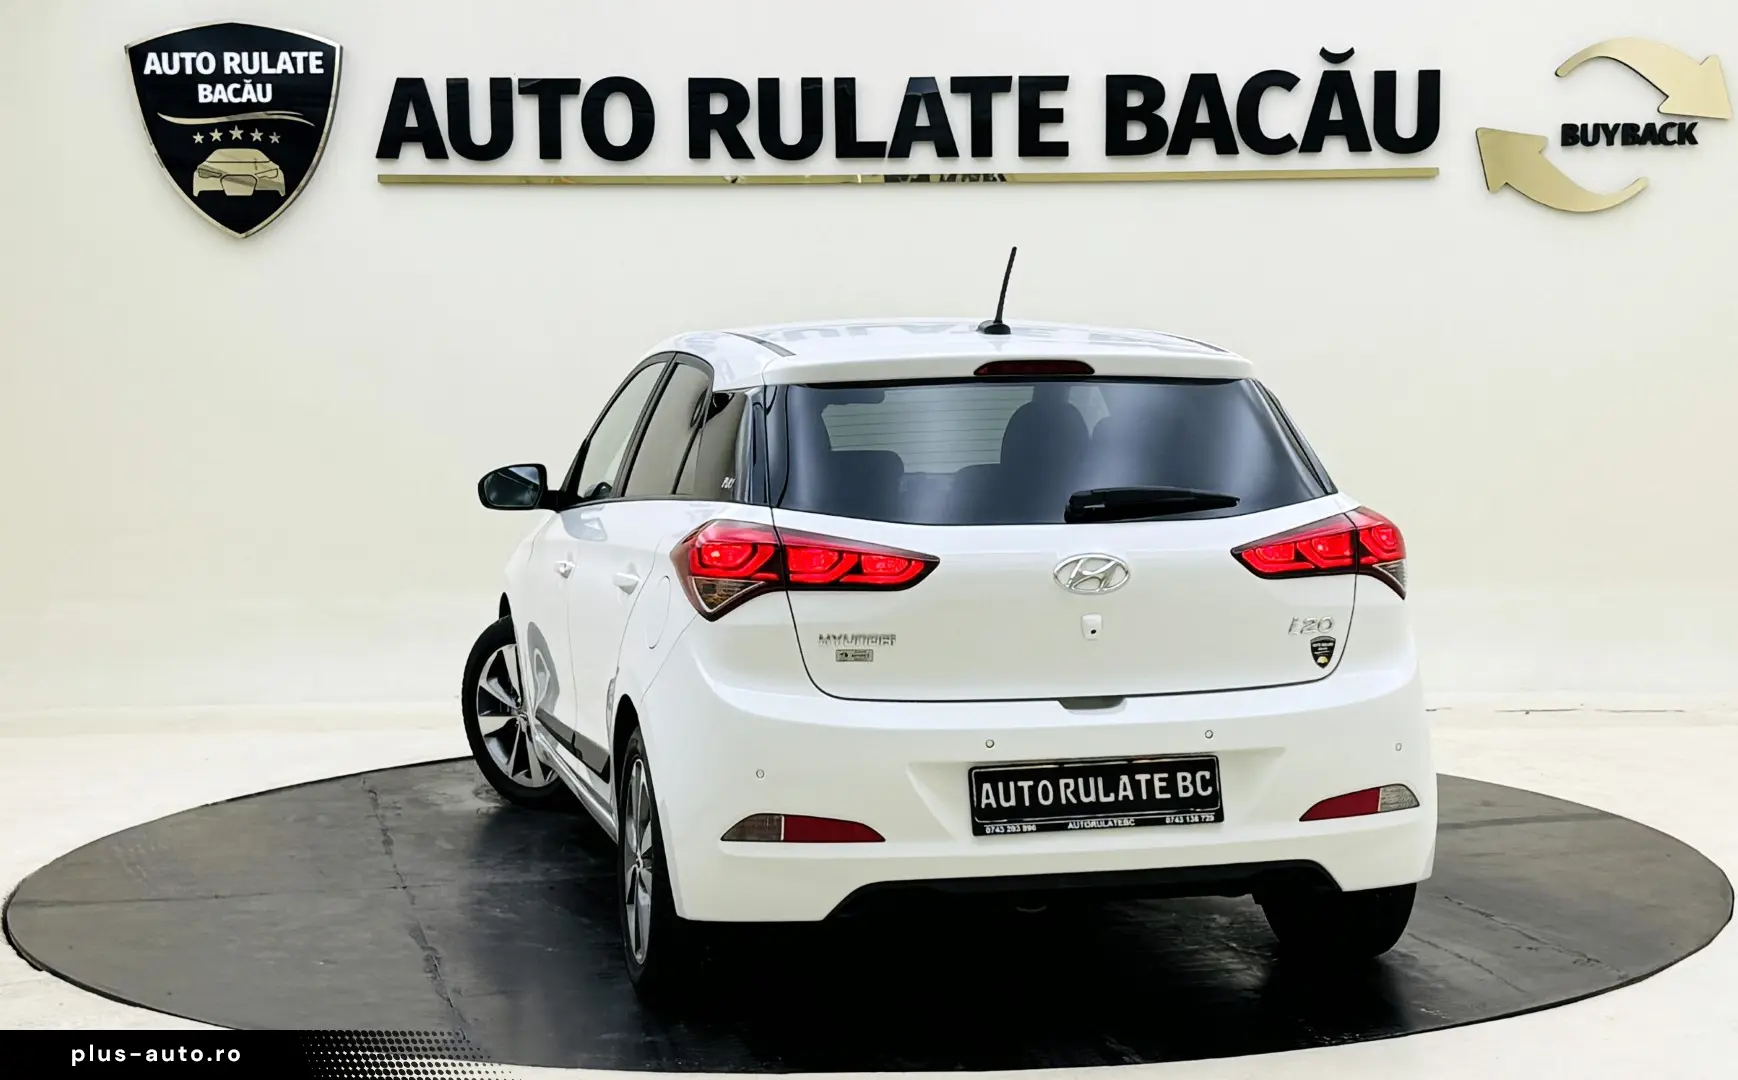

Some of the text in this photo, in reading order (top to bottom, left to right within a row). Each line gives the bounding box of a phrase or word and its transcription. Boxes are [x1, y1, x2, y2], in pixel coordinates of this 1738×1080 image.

[143, 51, 324, 76] AUTO RULATE
[197, 79, 273, 104] BACĂU
[376, 46, 1441, 161] AUTO RULATE BACĂU
[1561, 121, 1699, 147] BUYBACK
[980, 770, 1213, 809] AUTO RULATE BC
